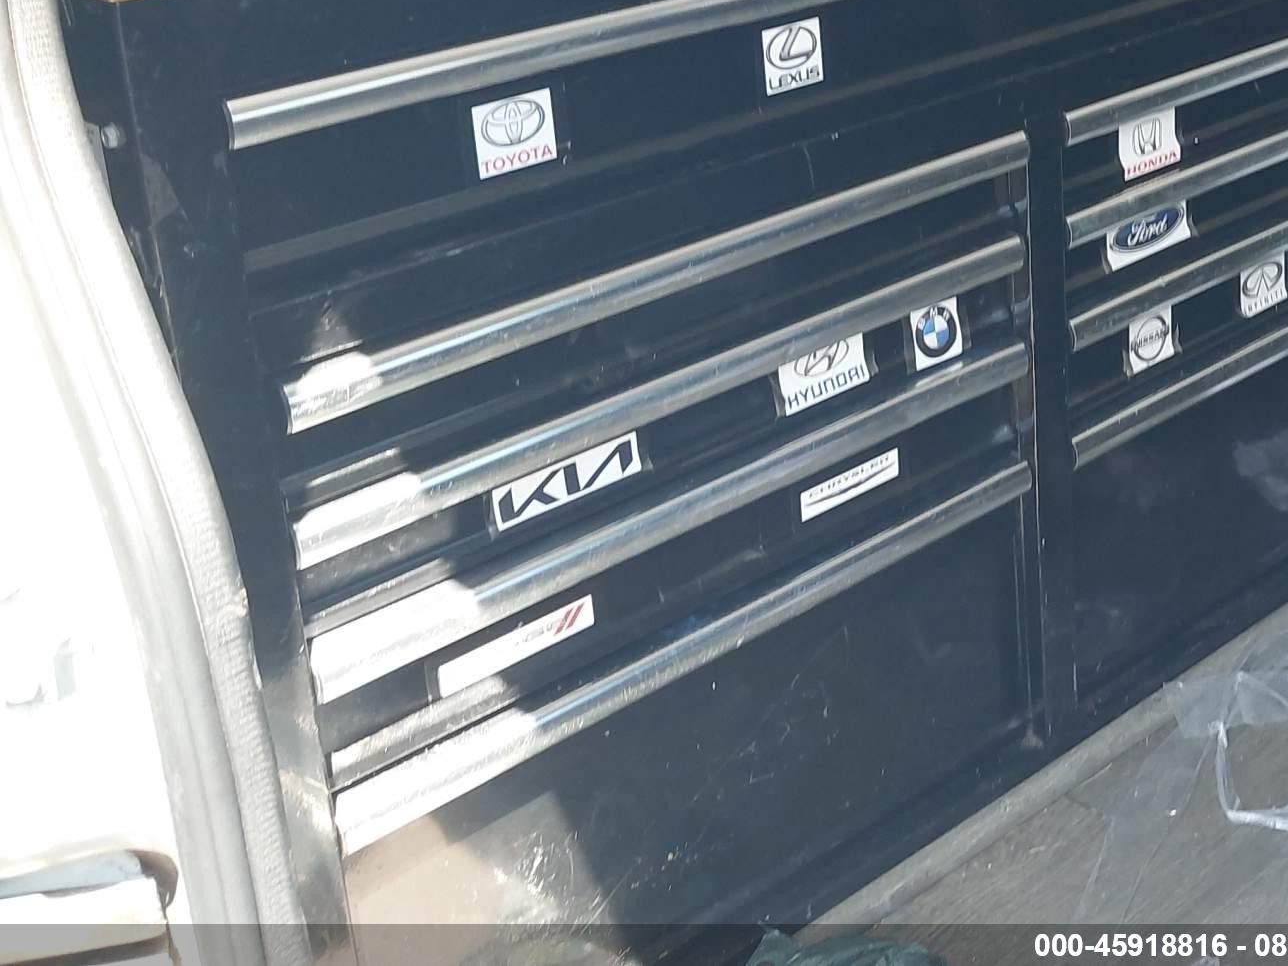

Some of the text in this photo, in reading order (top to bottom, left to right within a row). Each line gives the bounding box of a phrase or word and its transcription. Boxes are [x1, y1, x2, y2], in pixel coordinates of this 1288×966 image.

[768, 65, 821, 91] LEXUS
[481, 144, 553, 174] TOYOTA
[1126, 151, 1178, 176] HONDA
[1127, 212, 1169, 247] Ford
[1130, 325, 1170, 353] NISSAN
[787, 363, 867, 411] HYUNDAI
[498, 439, 634, 524] KIA
